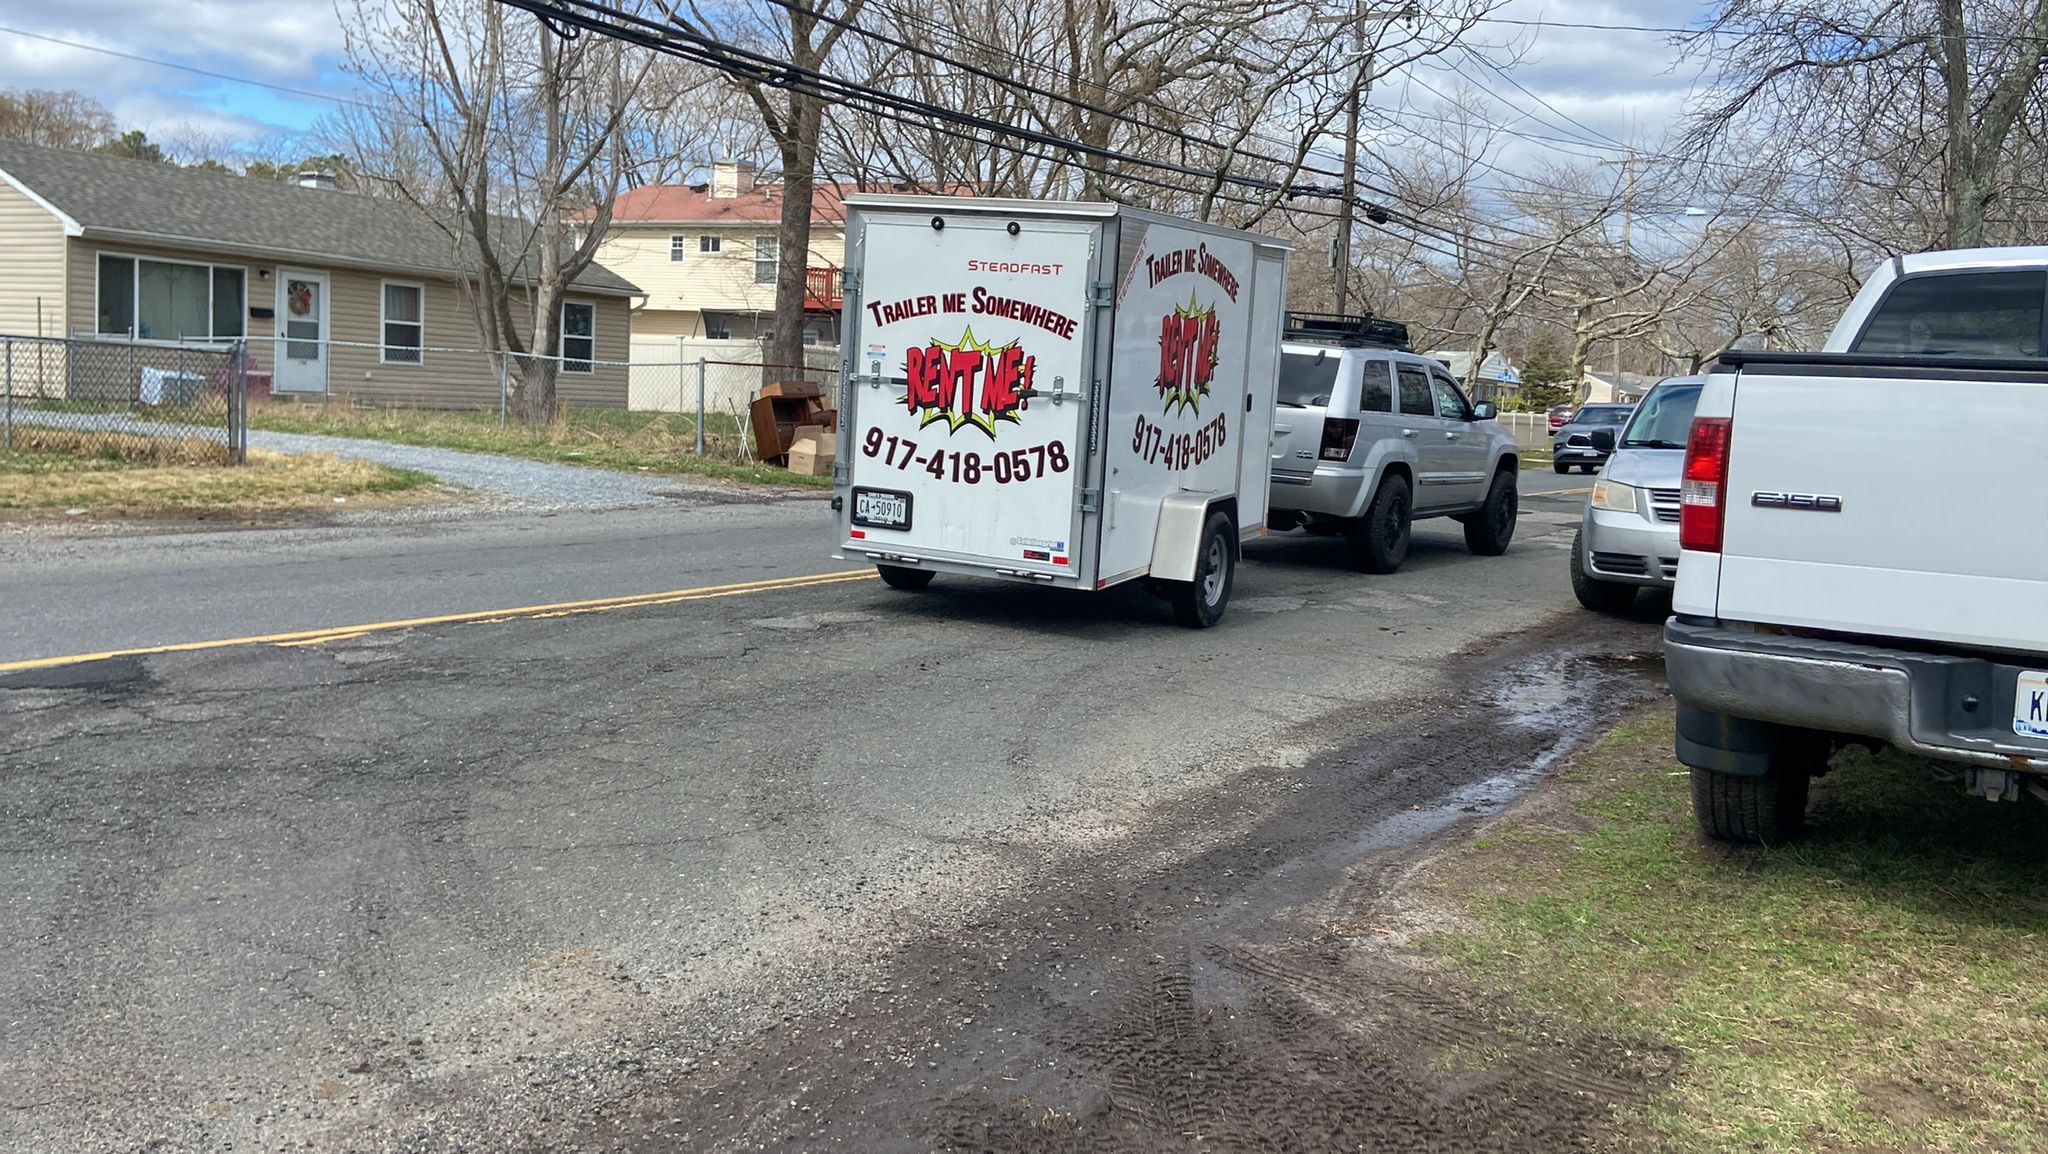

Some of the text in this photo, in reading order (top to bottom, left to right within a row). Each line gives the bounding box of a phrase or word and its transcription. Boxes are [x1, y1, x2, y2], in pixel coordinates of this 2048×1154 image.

[968, 260, 1063, 276] STEADFAST
[1146, 242, 1239, 304] TRAILER ME SOMEWHERE
[867, 286, 1078, 341] TRAILER ME SOMEWHERE
[907, 345, 983, 417] RENT
[863, 427, 1069, 484] 917-418-0578
[1132, 412, 1226, 471] 917-418-0578
